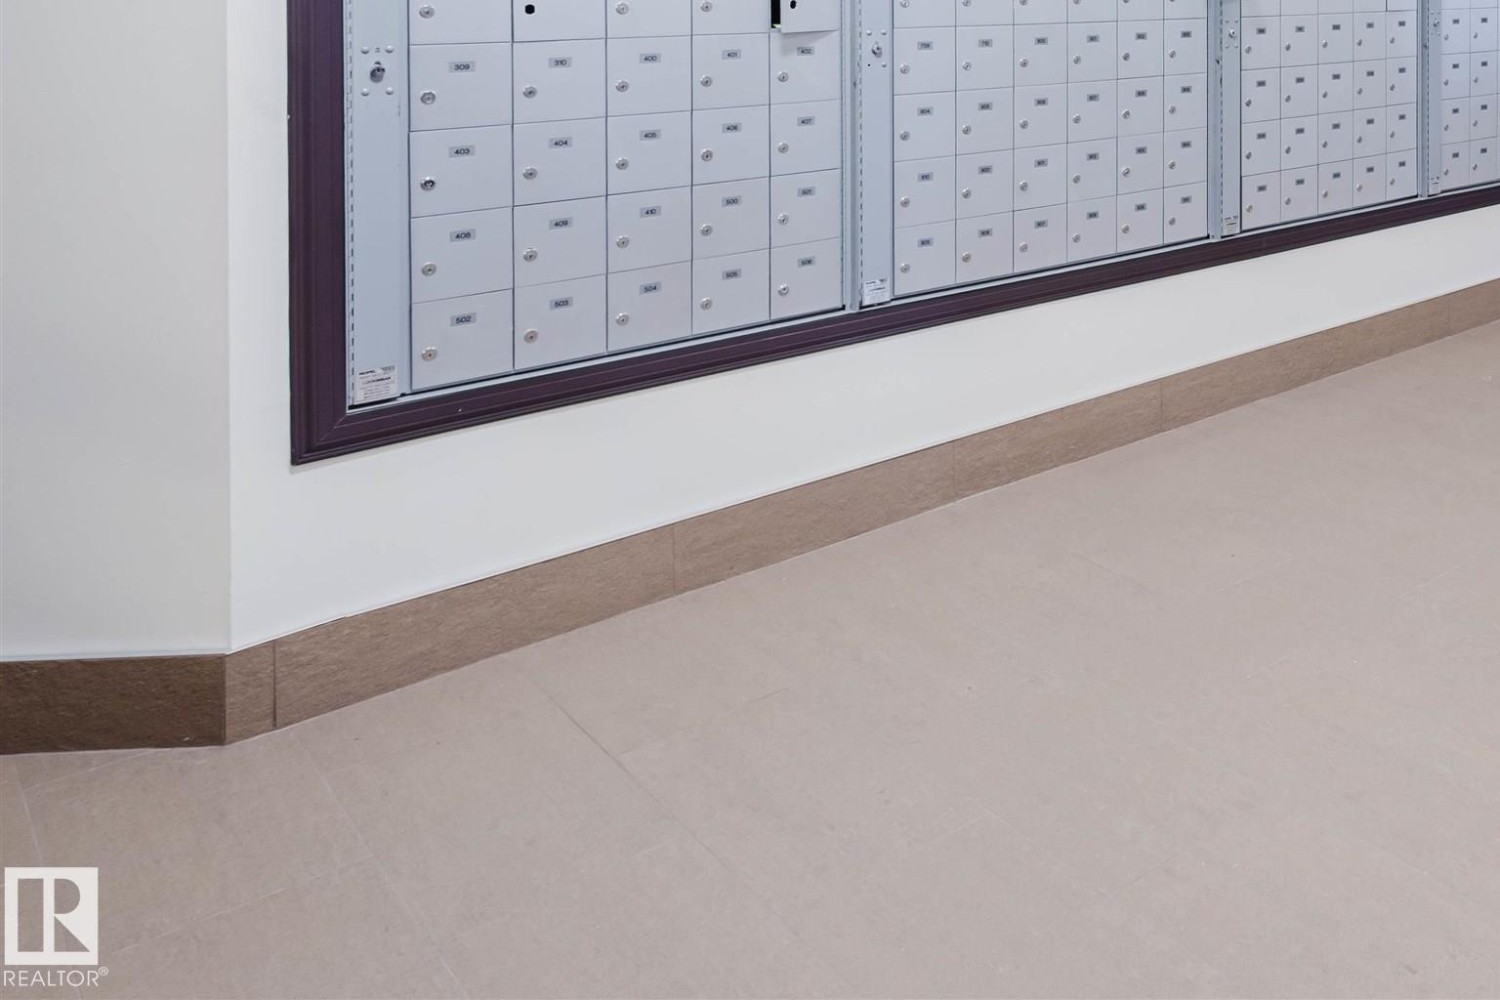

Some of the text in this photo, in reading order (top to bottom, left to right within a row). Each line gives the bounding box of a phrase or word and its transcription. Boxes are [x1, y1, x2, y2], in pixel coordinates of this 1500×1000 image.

[454, 63, 471, 71] 309
[553, 219, 569, 228] 409
[644, 285, 657, 293] 504
[554, 299, 569, 308] 503
[455, 315, 472, 325] 502
